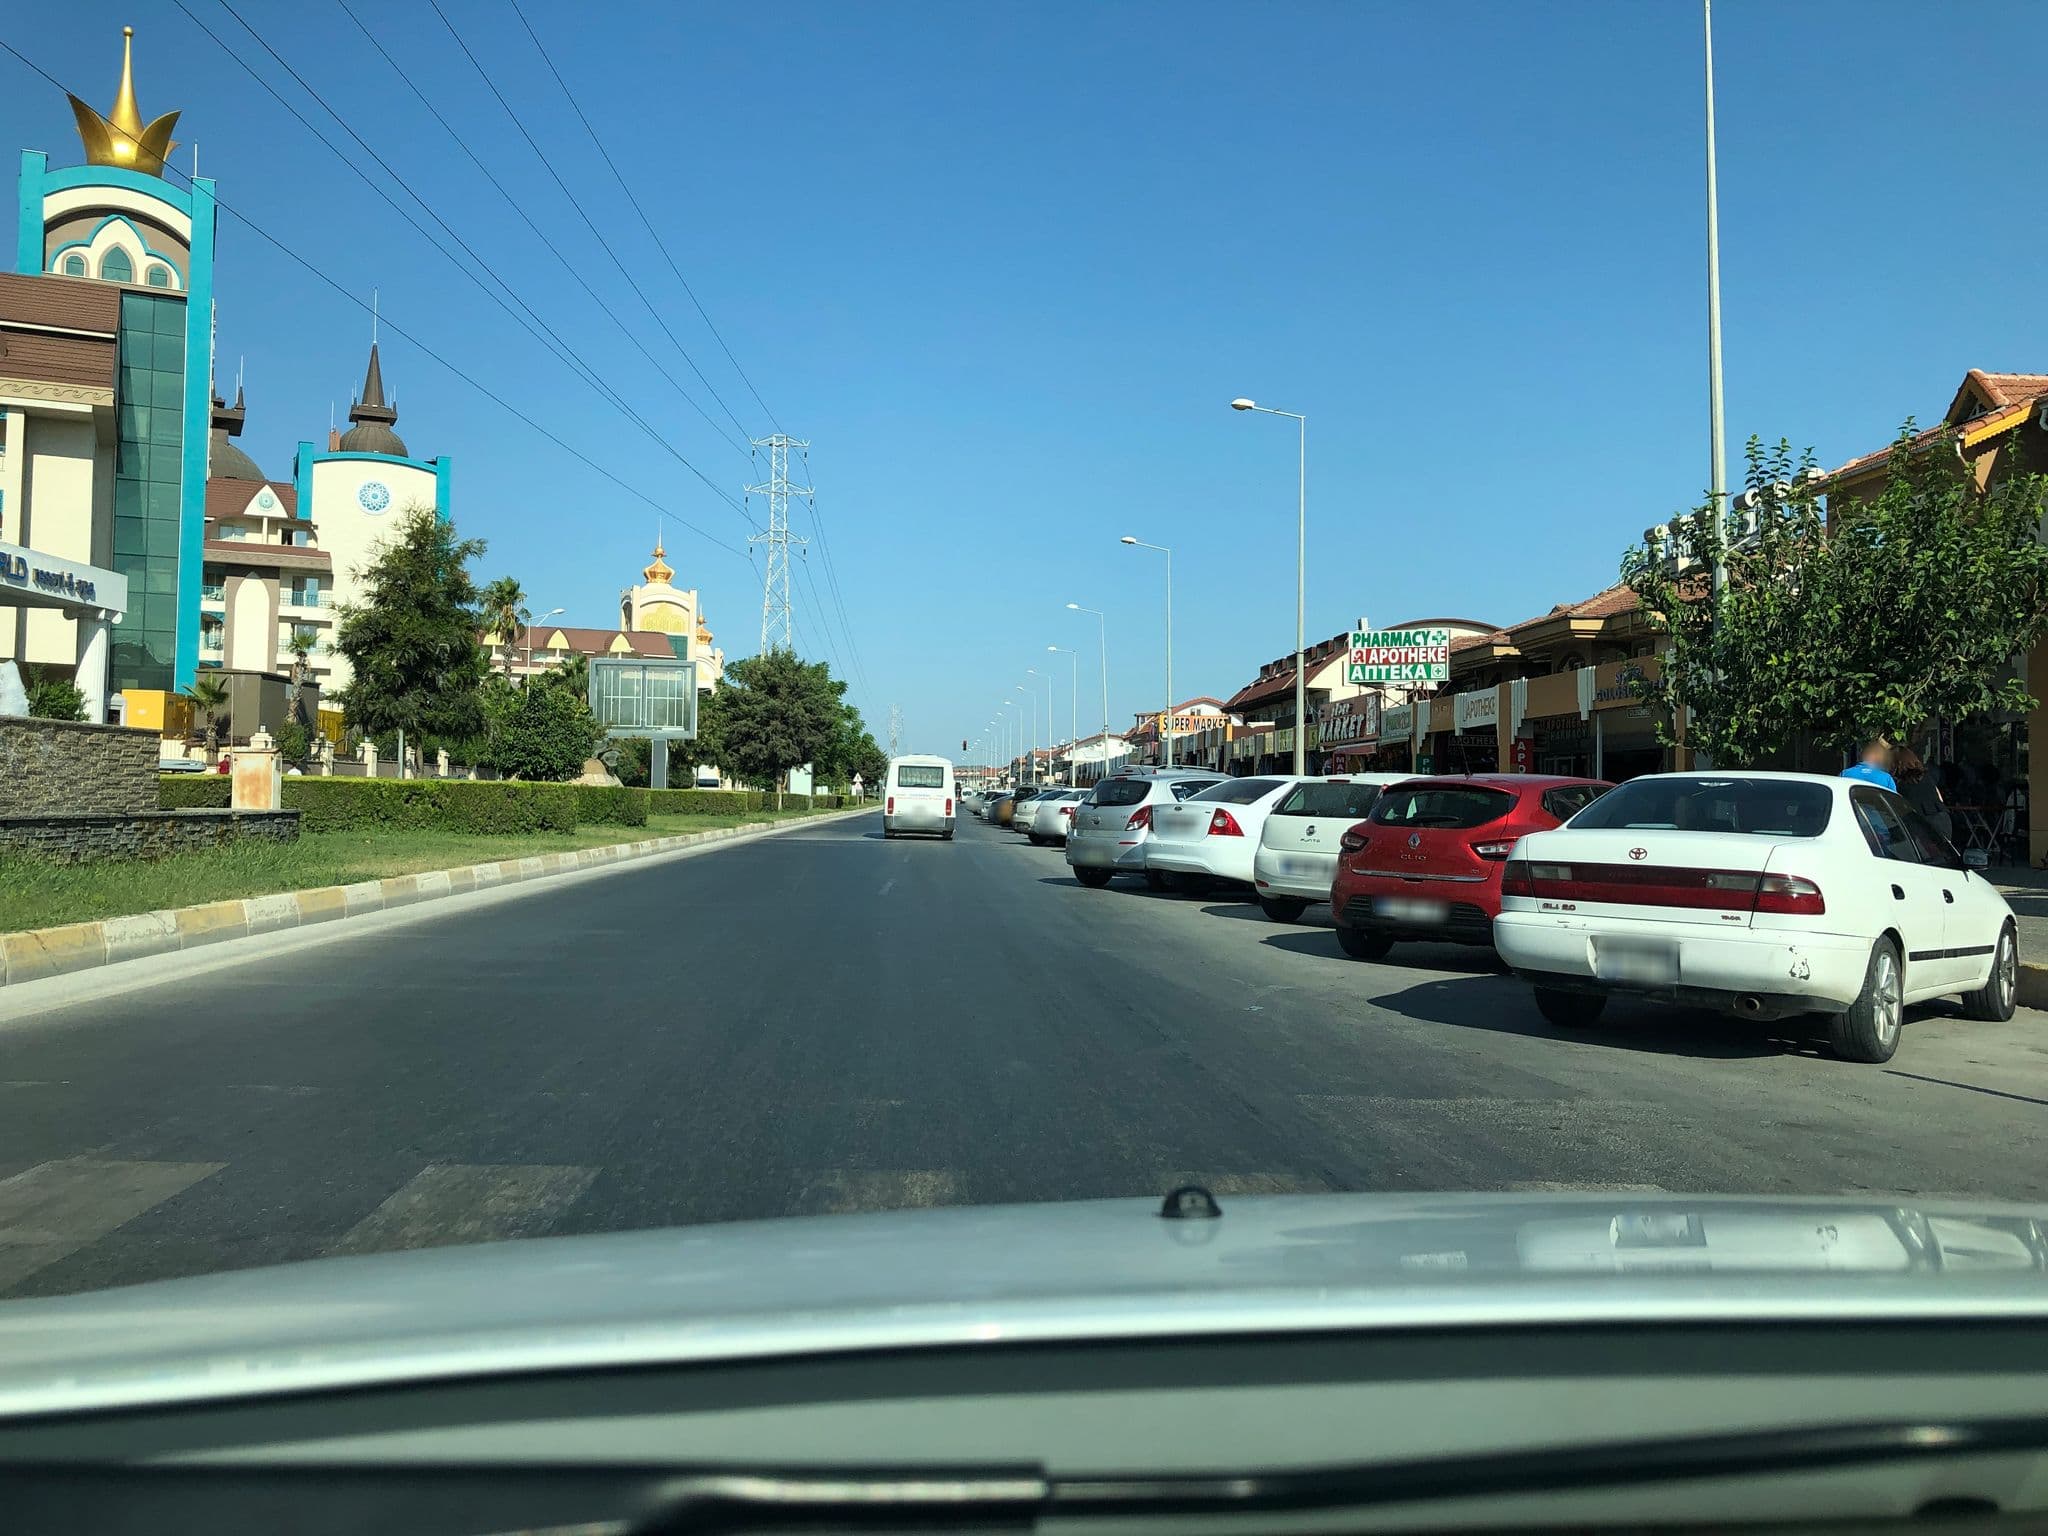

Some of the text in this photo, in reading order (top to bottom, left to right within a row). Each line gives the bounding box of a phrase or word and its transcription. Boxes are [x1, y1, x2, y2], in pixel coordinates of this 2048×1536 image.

[1352, 630, 1431, 648] PHARMACY
[1368, 646, 1446, 664] APOTHEKE
[1351, 663, 1427, 680] АПТЕКА
[1163, 717, 1190, 731] SUPER
[1318, 714, 1365, 743] MARKET
